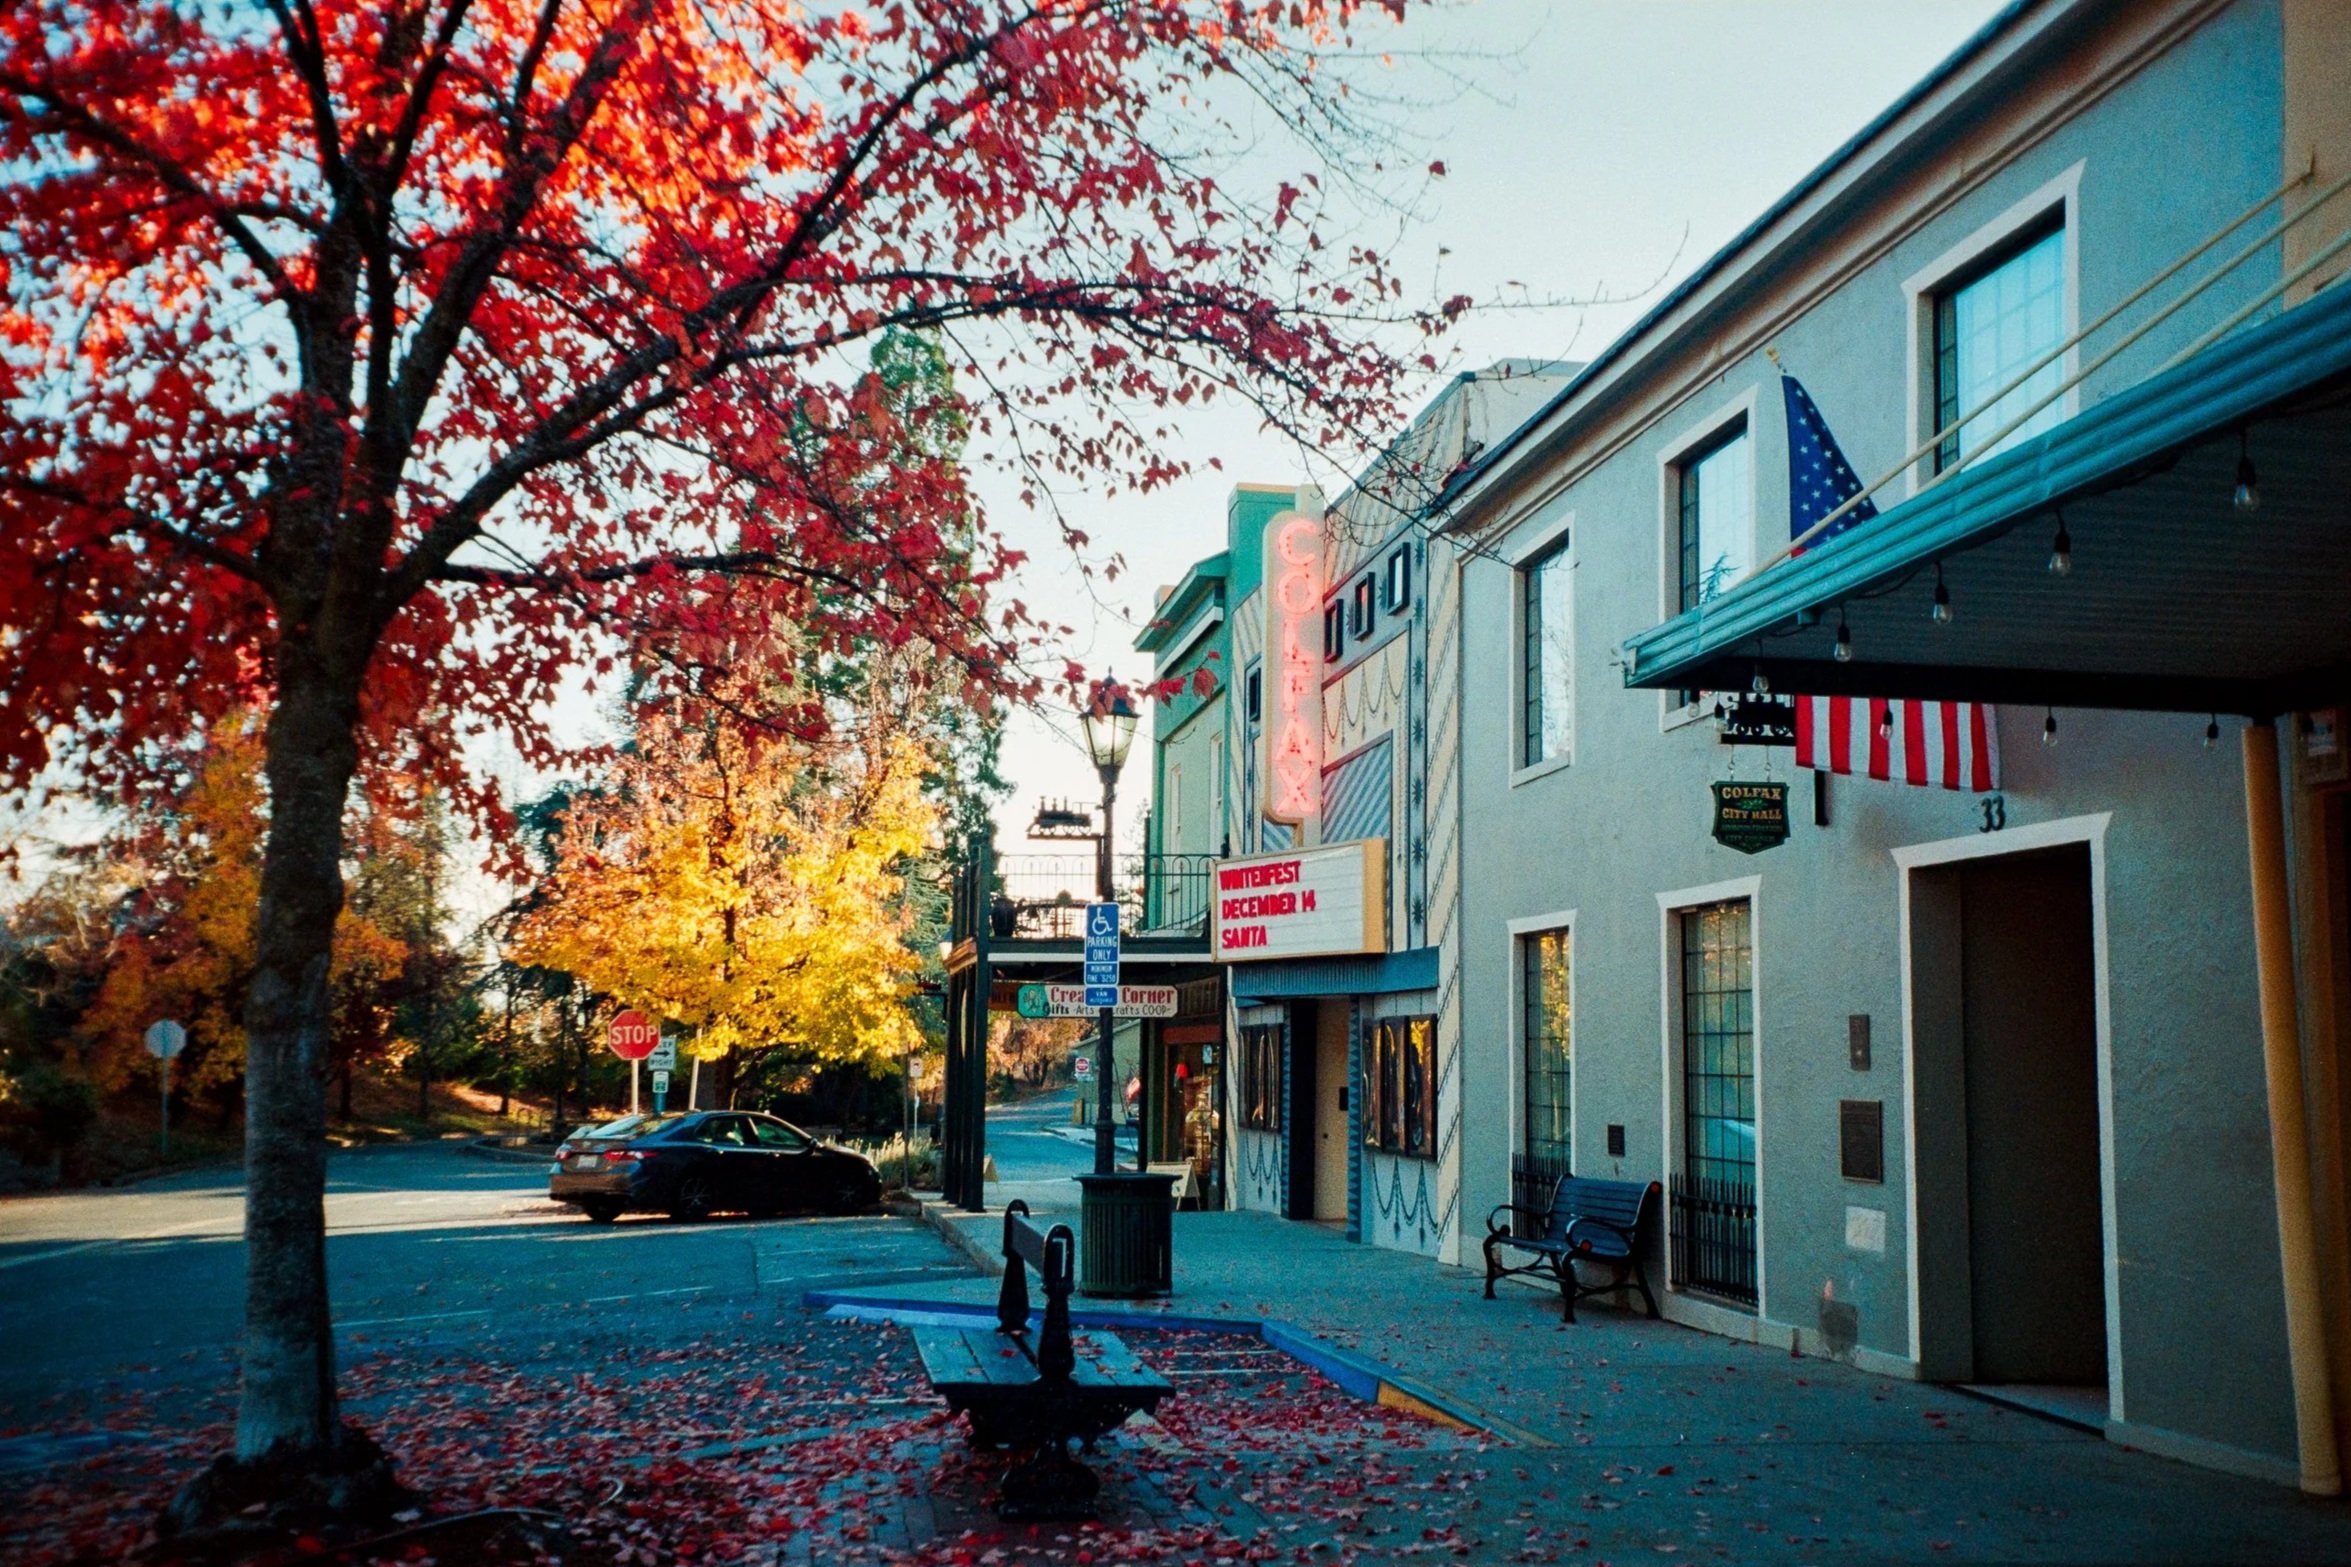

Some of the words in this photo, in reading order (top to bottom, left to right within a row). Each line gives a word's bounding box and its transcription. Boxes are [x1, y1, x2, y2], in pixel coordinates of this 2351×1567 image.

[1275, 519, 1319, 814] COLFAX
[1722, 786, 1782, 800] COLFAX
[1722, 808, 1748, 819] CITY
[1751, 808, 1782, 820] HALL
[1979, 796, 2006, 833] 33
[1219, 860, 1301, 891] WINTERFEST
[1222, 892, 1296, 920] DECEMBER
[1302, 889, 1316, 912] 14
[1087, 937, 1117, 948] PARKING
[1222, 925, 1267, 949] SANTA
[1092, 949, 1111, 961] ONLY
[1122, 986, 1174, 1004] Corner
[611, 1025, 657, 1045] STOP
